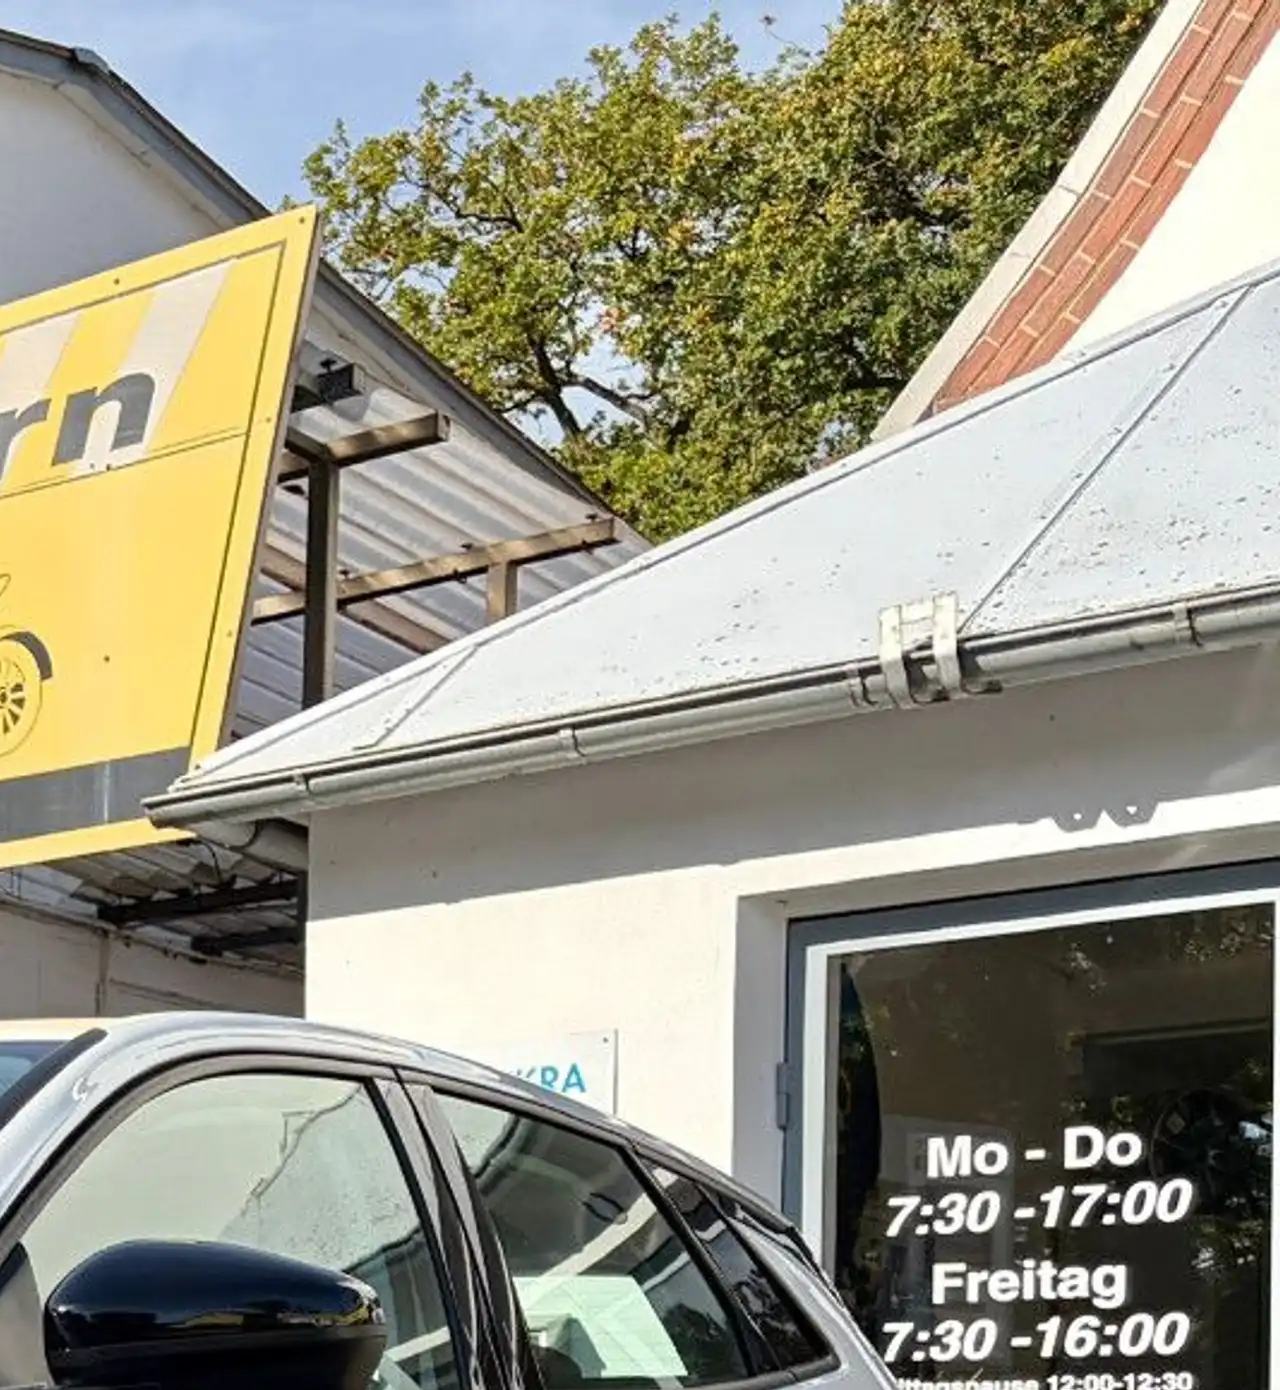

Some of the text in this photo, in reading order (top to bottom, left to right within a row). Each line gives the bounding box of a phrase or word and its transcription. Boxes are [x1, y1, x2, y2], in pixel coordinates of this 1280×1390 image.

[927, 1126, 1142, 1178] Mo - Do
[885, 1191, 1001, 1237] 7:30
[932, 1259, 1128, 1308] Freitag
[883, 1319, 998, 1363] 7:30
